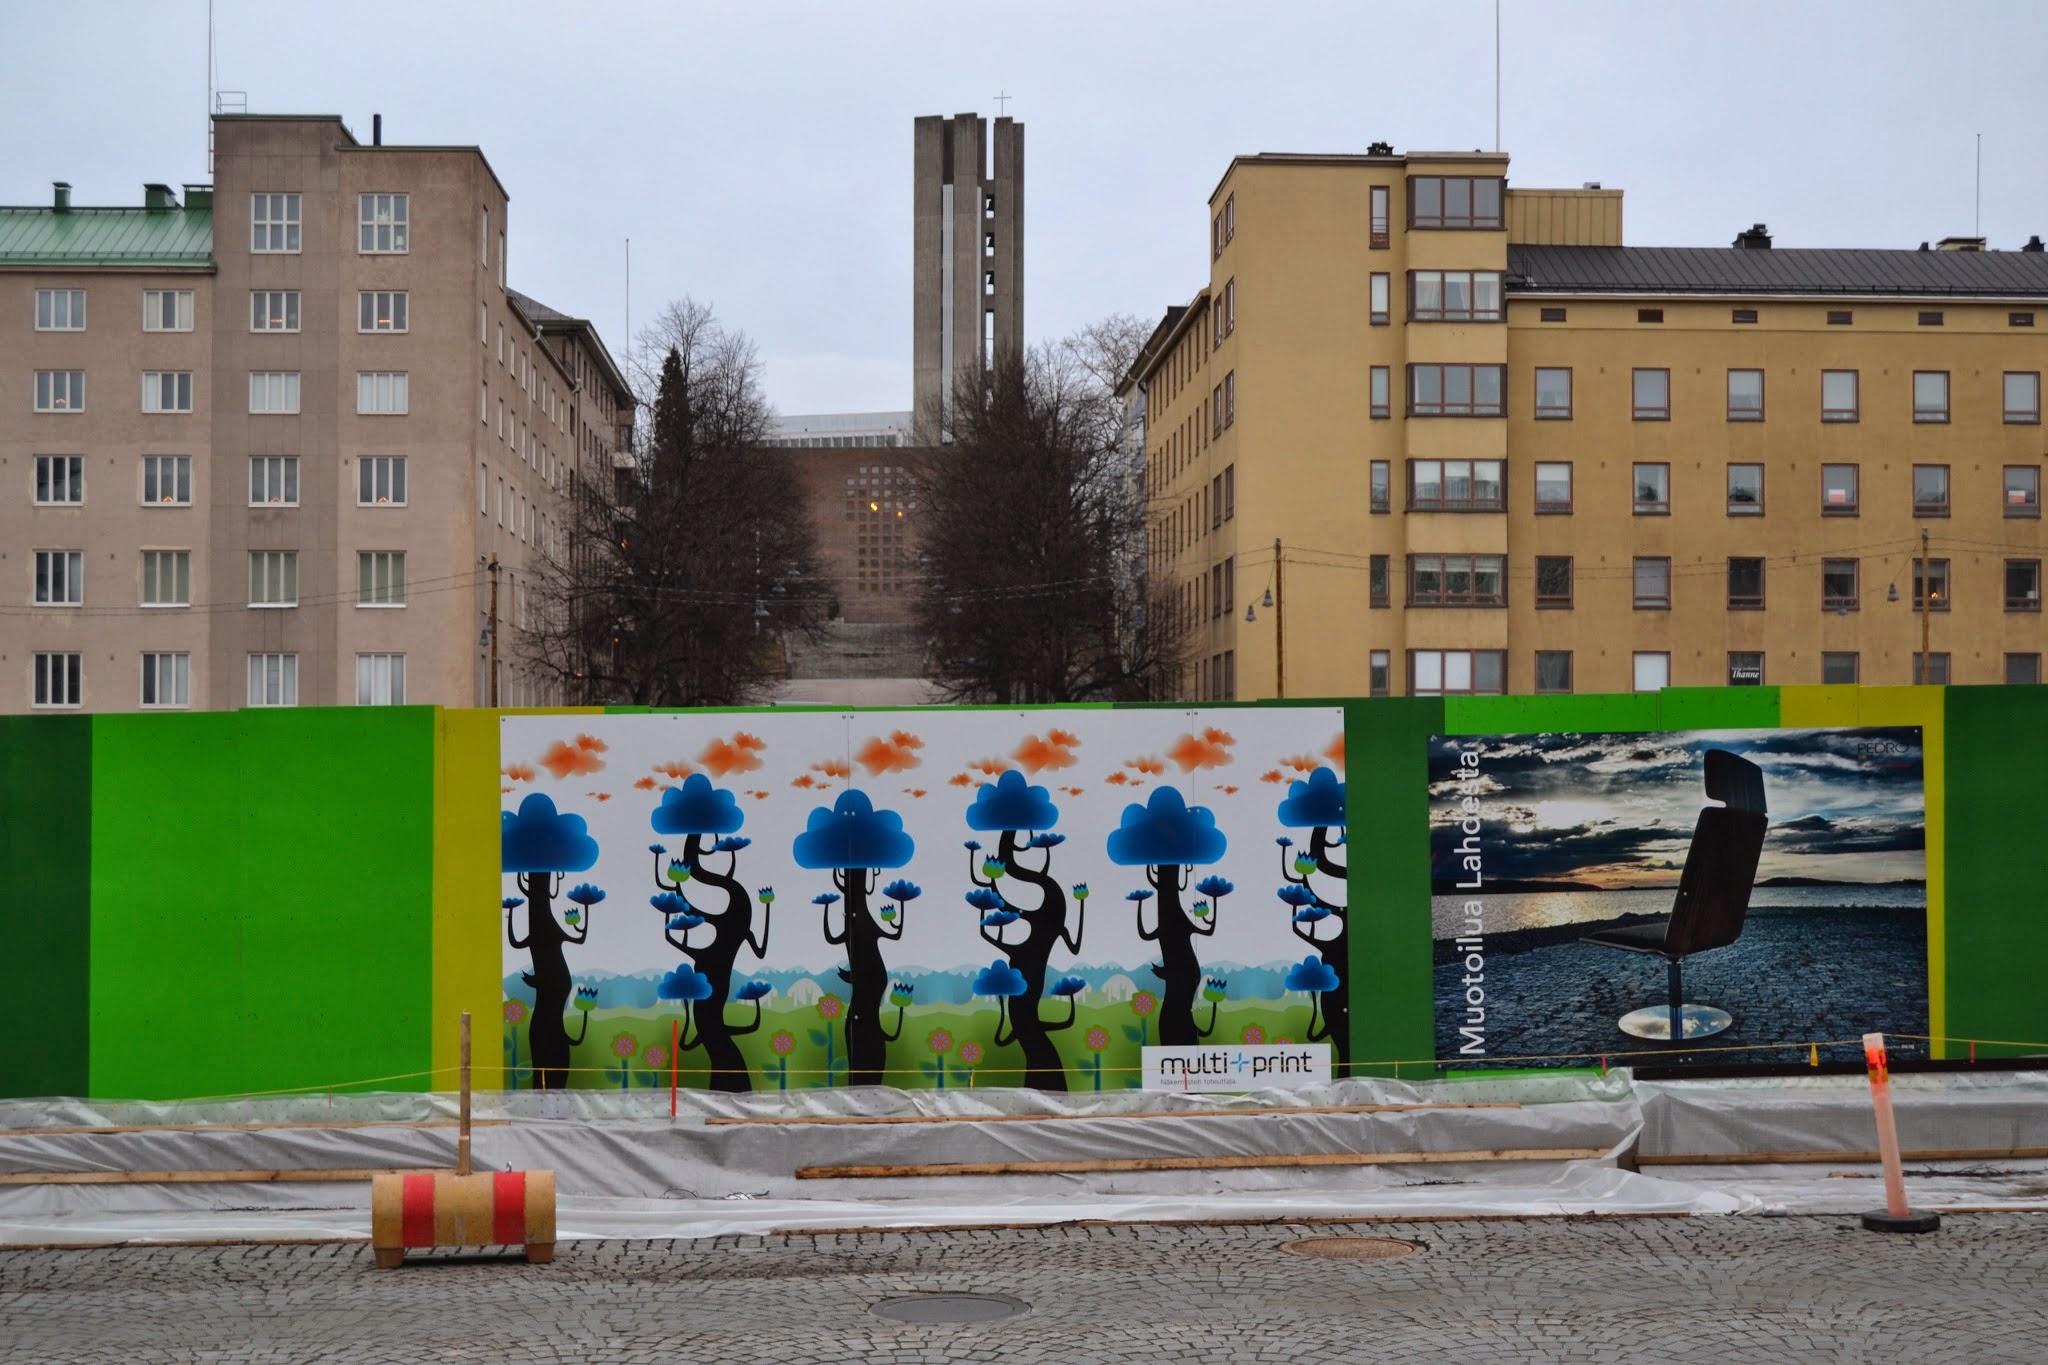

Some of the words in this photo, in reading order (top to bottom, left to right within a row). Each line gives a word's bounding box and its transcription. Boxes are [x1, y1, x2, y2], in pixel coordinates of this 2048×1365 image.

[1857, 742, 1909, 754] PEDRO
[1452, 751, 1482, 889] Lahdesta
[1456, 899, 1486, 1055] Muotoilua
